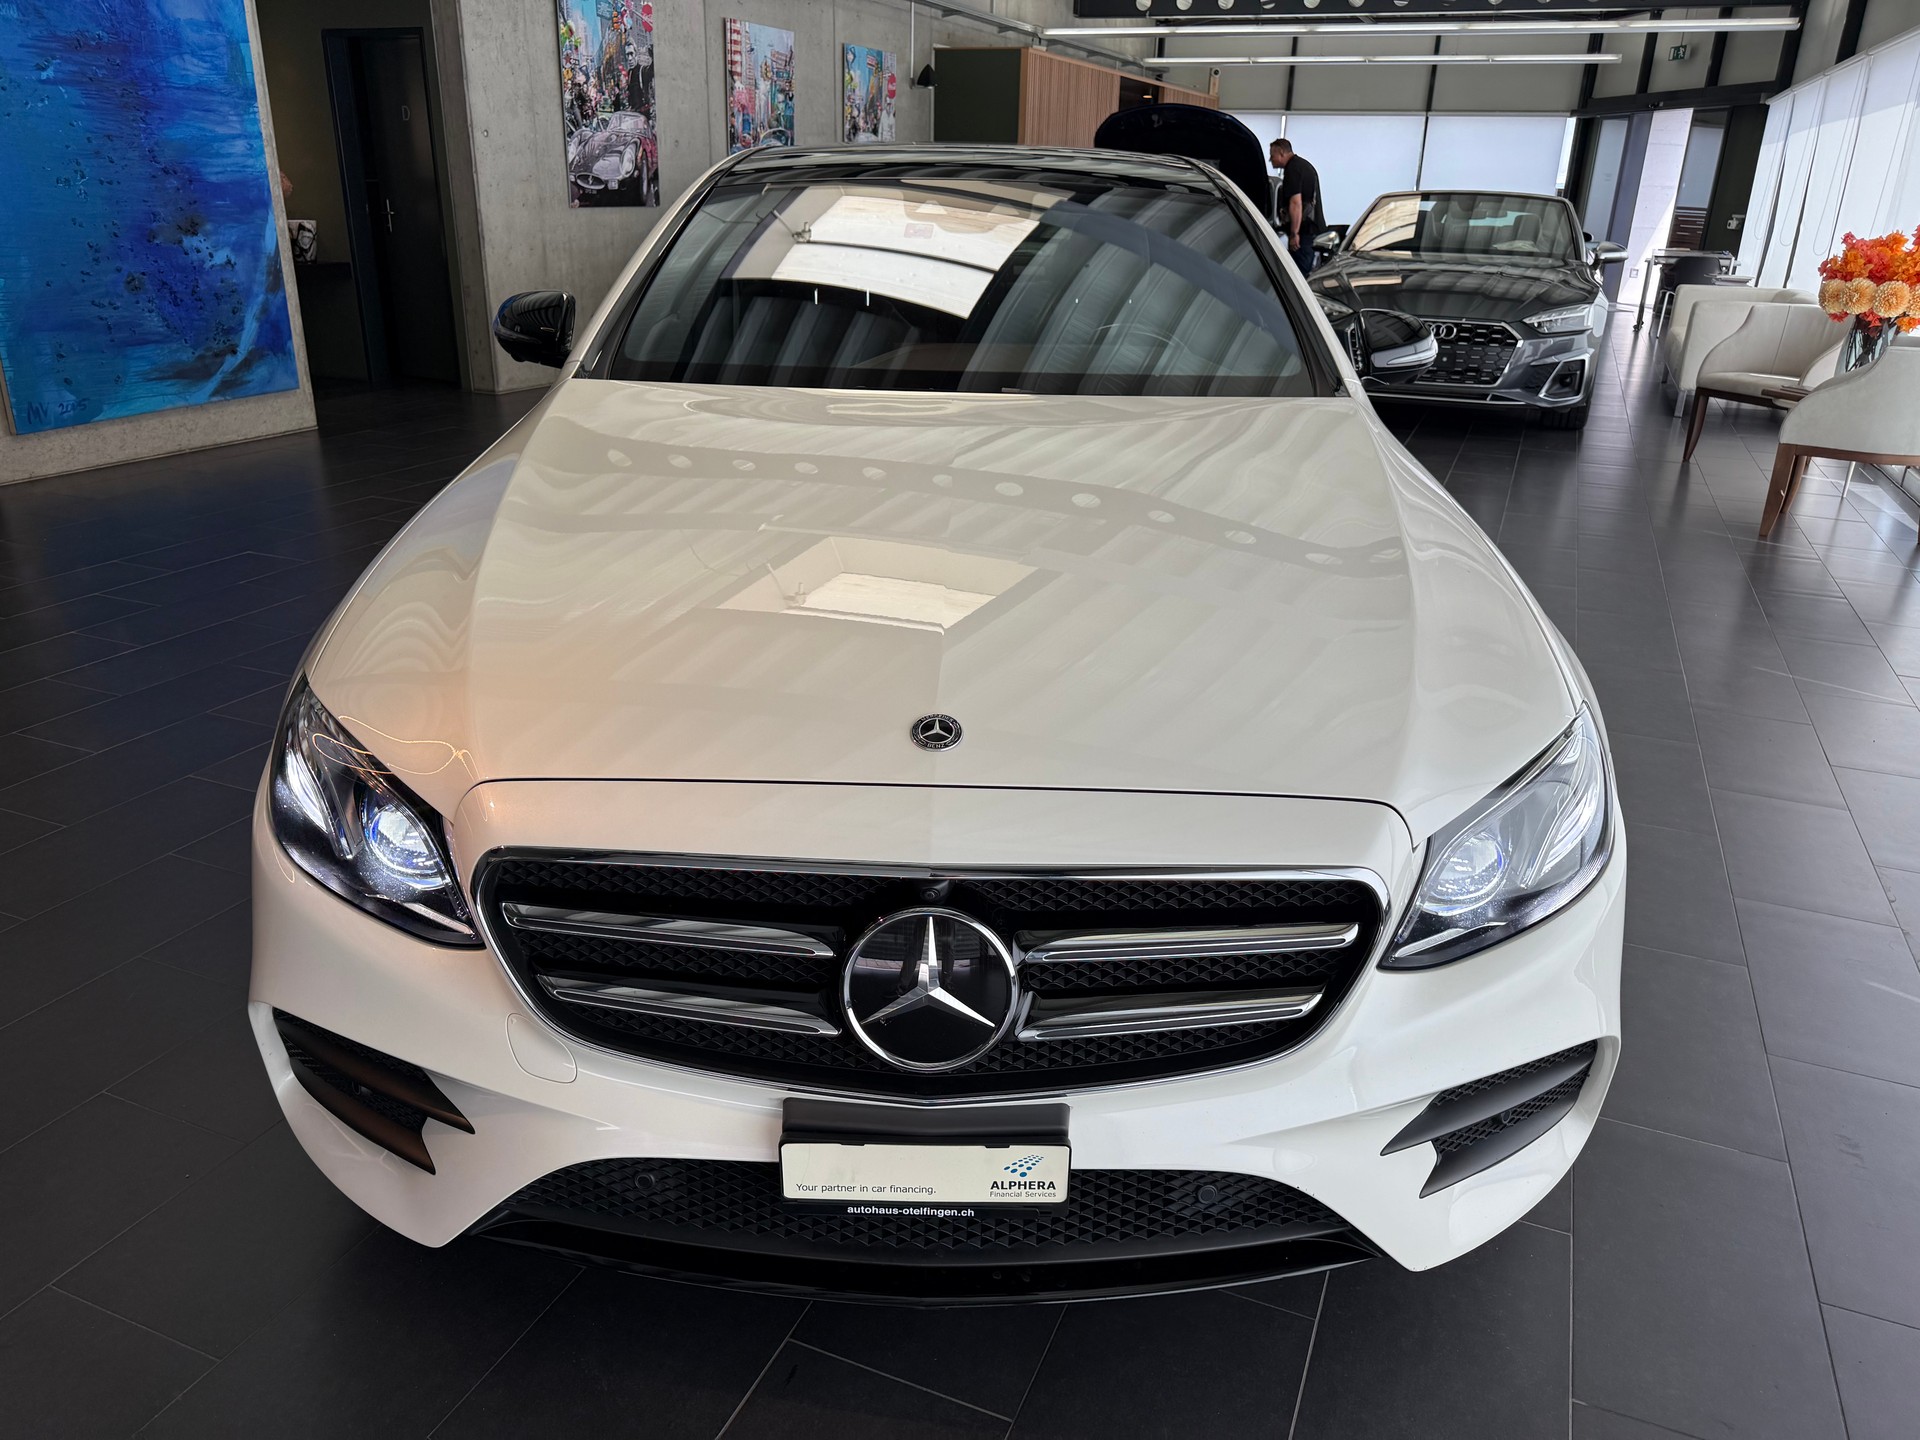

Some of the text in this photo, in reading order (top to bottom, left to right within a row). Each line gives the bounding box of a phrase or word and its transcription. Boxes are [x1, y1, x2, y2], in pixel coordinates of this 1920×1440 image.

[796, 1183, 818, 1192] Your
[821, 1184, 857, 1196] partner
[859, 1184, 868, 1192] in
[889, 1184, 936, 1195] financing.
[990, 1180, 1056, 1190] ALPHERA
[847, 1205, 975, 1217] autohaus-otelfingen.ch
